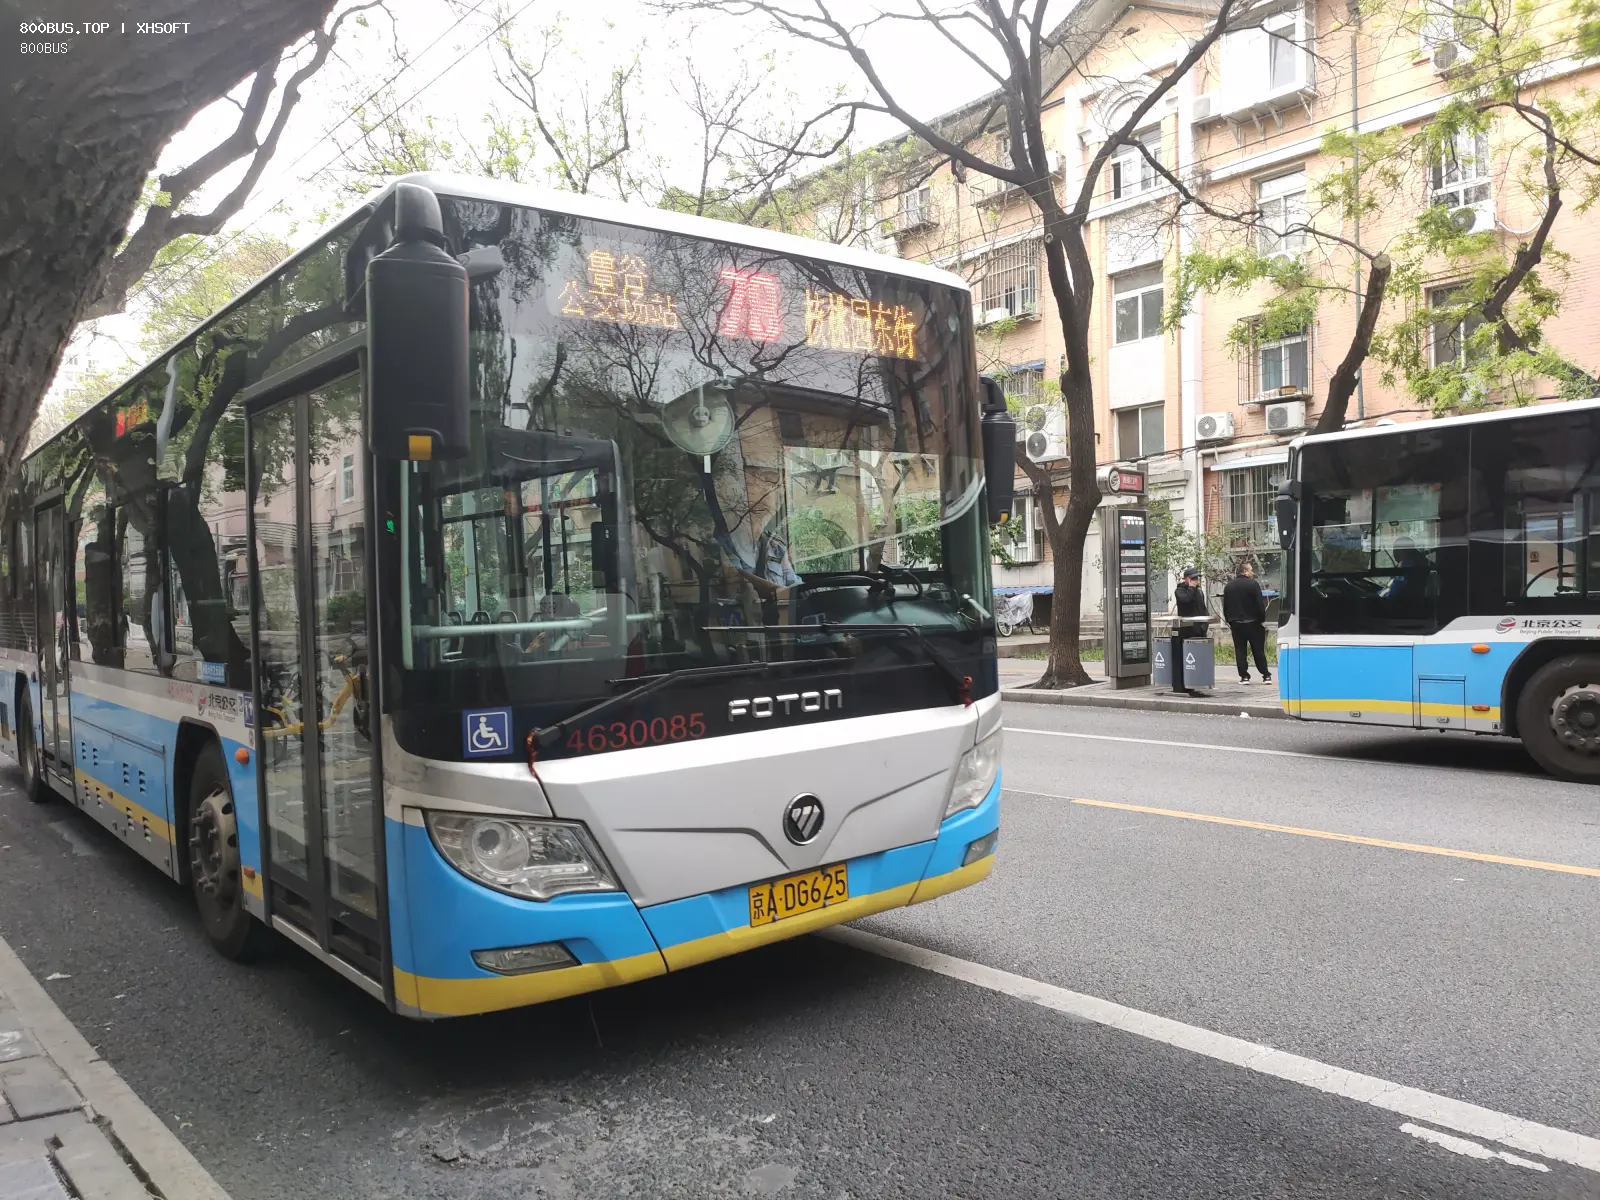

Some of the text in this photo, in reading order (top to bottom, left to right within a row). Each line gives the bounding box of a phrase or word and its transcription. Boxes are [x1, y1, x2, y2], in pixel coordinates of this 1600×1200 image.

[557, 280, 679, 330] 公交场站
[719, 269, 783, 344] 70
[1521, 618, 1583, 629] 北京公交
[728, 688, 843, 722] FOTON
[566, 712, 707, 753] 4630085
